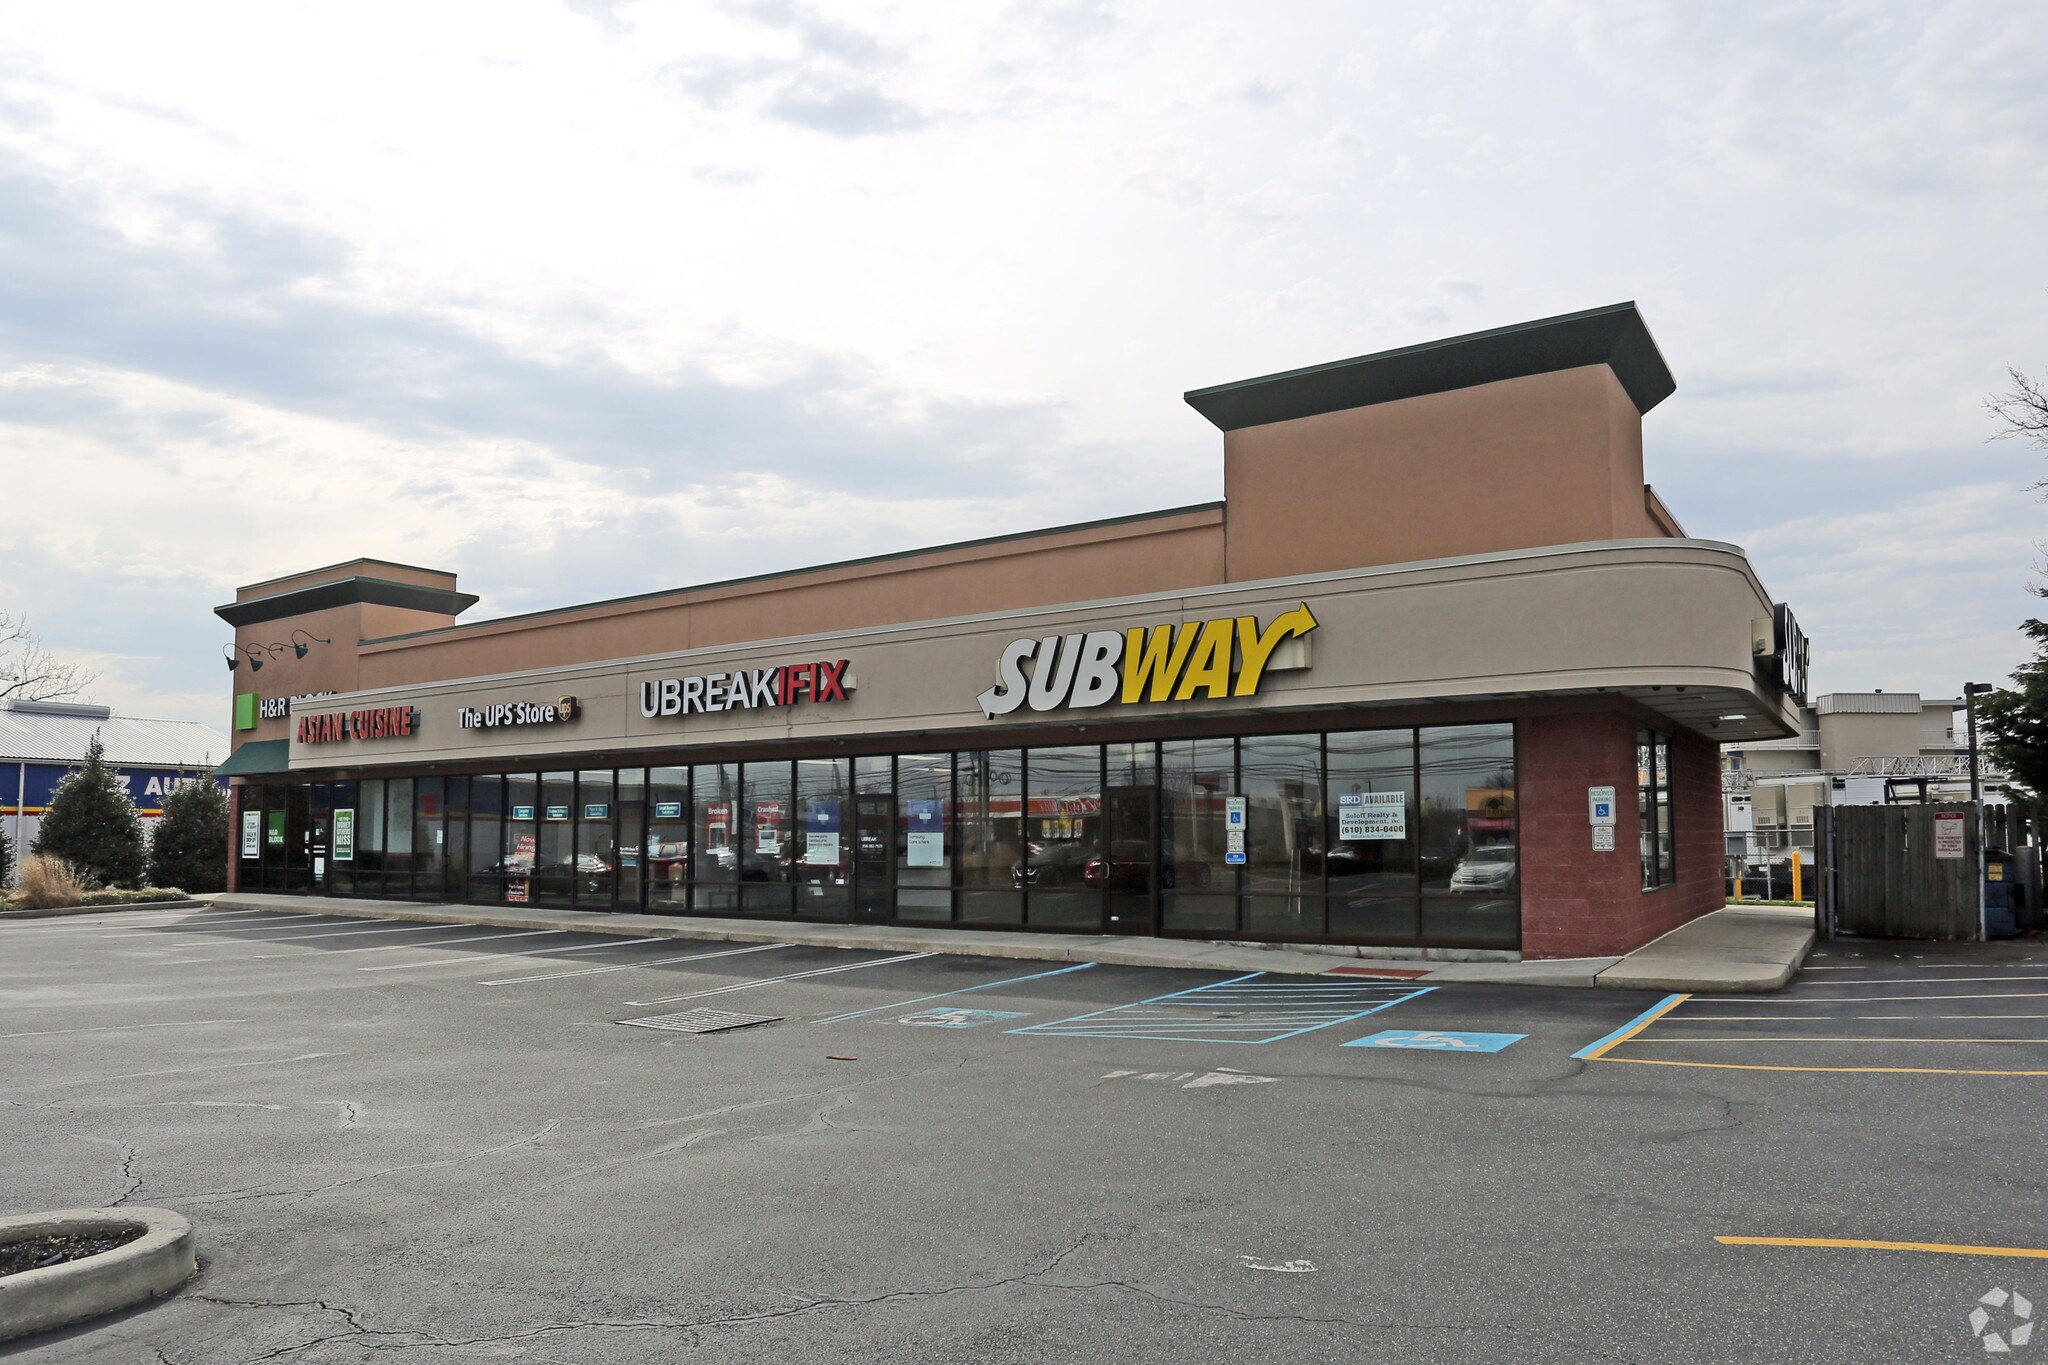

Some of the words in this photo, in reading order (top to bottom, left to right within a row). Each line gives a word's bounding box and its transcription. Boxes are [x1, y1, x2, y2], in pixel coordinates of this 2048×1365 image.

[976, 601, 1319, 720] SUBWAY
[640, 659, 851, 719] UBREAKIFIX
[259, 697, 286, 719] H&R
[560, 703, 571, 717] ups
[458, 707, 481, 728] The
[485, 704, 513, 727] UPS
[516, 702, 554, 724] Store
[297, 712, 345, 743] ASIAN
[350, 705, 413, 740] CUISINE
[1340, 795, 1360, 804] SRD
[1365, 794, 1404, 804] AVAILABLE
[708, 807, 728, 815] Broken
[757, 805, 779, 813] Crashed
[1342, 826, 1363, 834] (610)
[1365, 825, 1404, 833] 834-0400
[336, 835, 351, 845] MISS
[516, 844, 536, 852] Hiring
